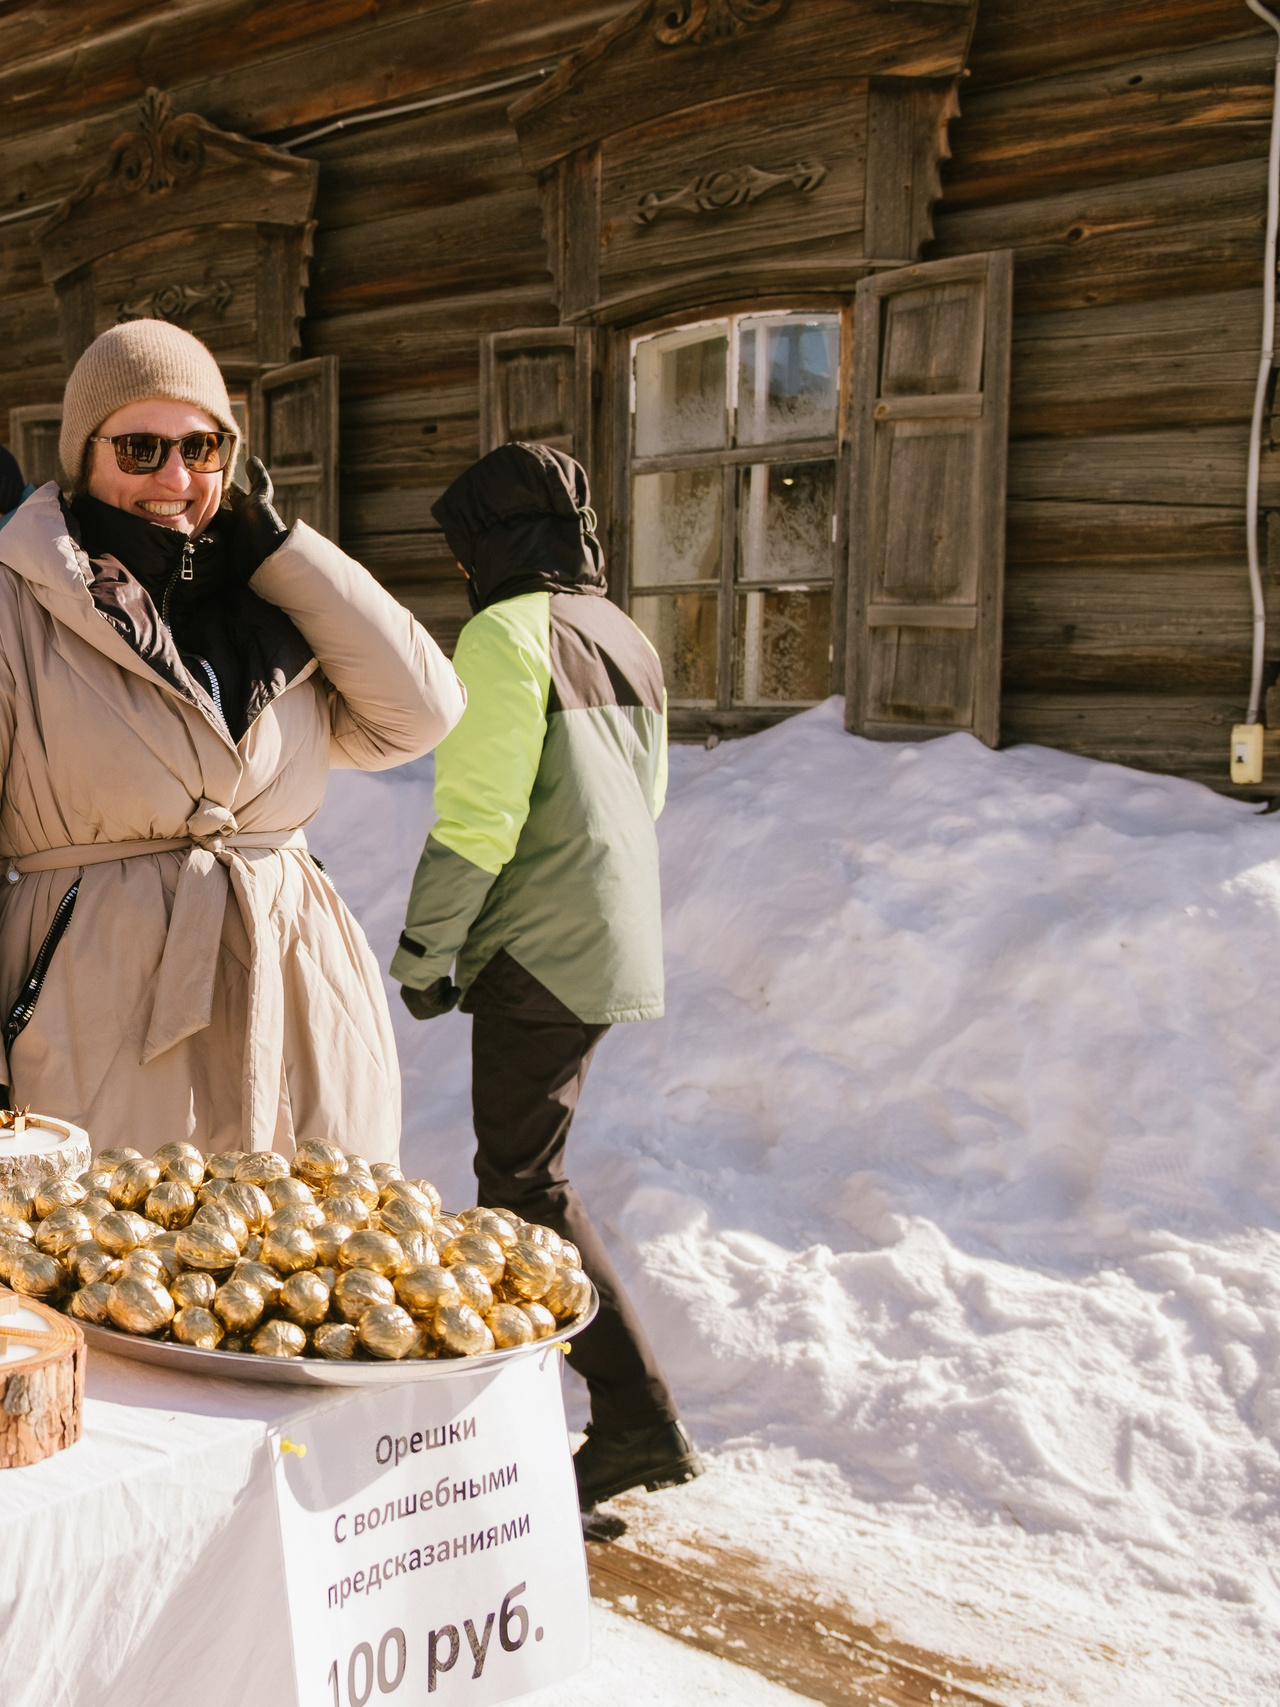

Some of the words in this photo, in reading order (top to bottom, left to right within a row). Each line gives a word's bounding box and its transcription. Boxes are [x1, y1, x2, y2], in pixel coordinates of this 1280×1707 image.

[375, 1417, 476, 1466] Орешки
[334, 1514, 347, 1544] С
[354, 1463, 518, 1536] волшебными
[328, 1514, 531, 1609] предсказаниями
[328, 1627, 406, 1707] 100
[427, 1581, 544, 1693] руб.
